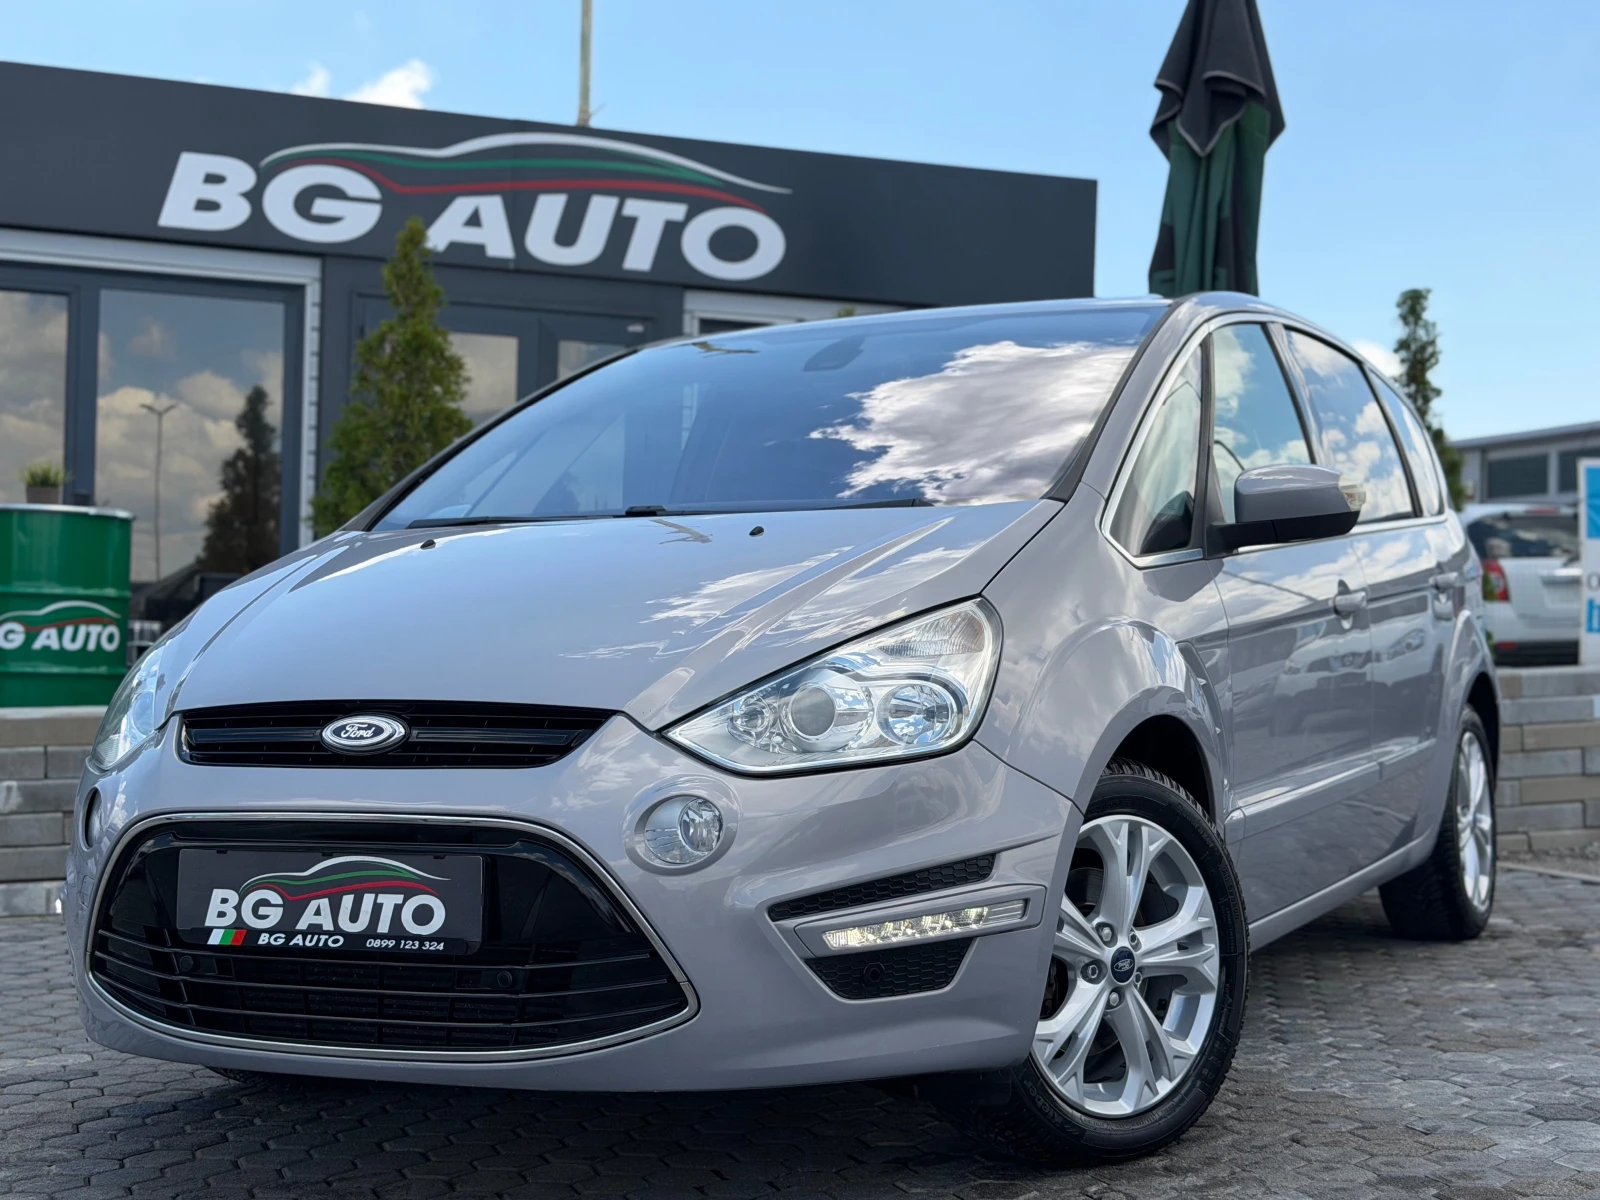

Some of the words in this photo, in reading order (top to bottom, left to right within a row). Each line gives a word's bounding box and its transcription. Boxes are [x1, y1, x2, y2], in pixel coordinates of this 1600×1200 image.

[157, 151, 382, 243] BG
[424, 194, 786, 281] AUTO
[0, 622, 26, 650] G
[31, 624, 120, 652] AUTO
[340, 723, 375, 738] Ford
[204, 888, 283, 929] BG
[295, 893, 446, 935] AUTO
[257, 933, 286, 945] BG
[289, 934, 345, 948] AUTO
[366, 938, 396, 948] 0899
[400, 939, 419, 949] 123
[422, 941, 445, 951] 324
